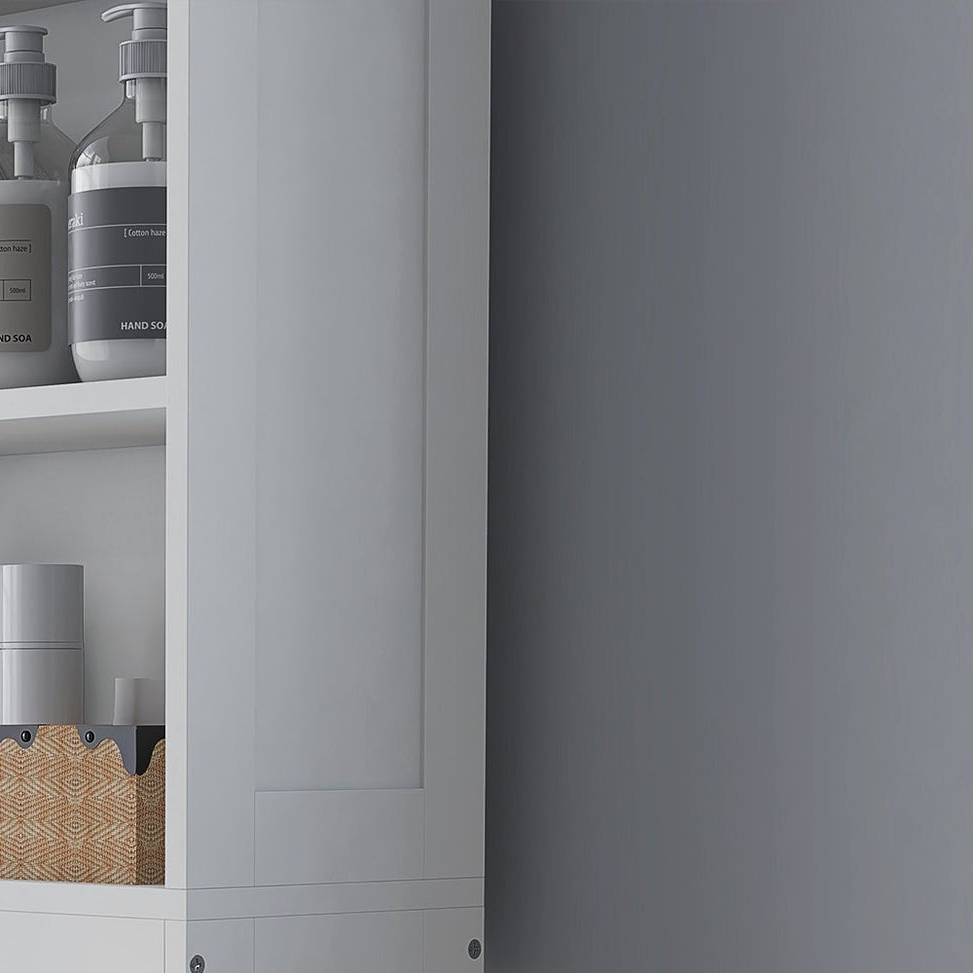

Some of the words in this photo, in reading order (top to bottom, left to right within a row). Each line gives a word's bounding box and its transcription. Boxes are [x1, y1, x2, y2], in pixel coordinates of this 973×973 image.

[128, 229, 149, 237] Cotton
[121, 322, 149, 330] HAND
[13, 334, 32, 343] SOA
